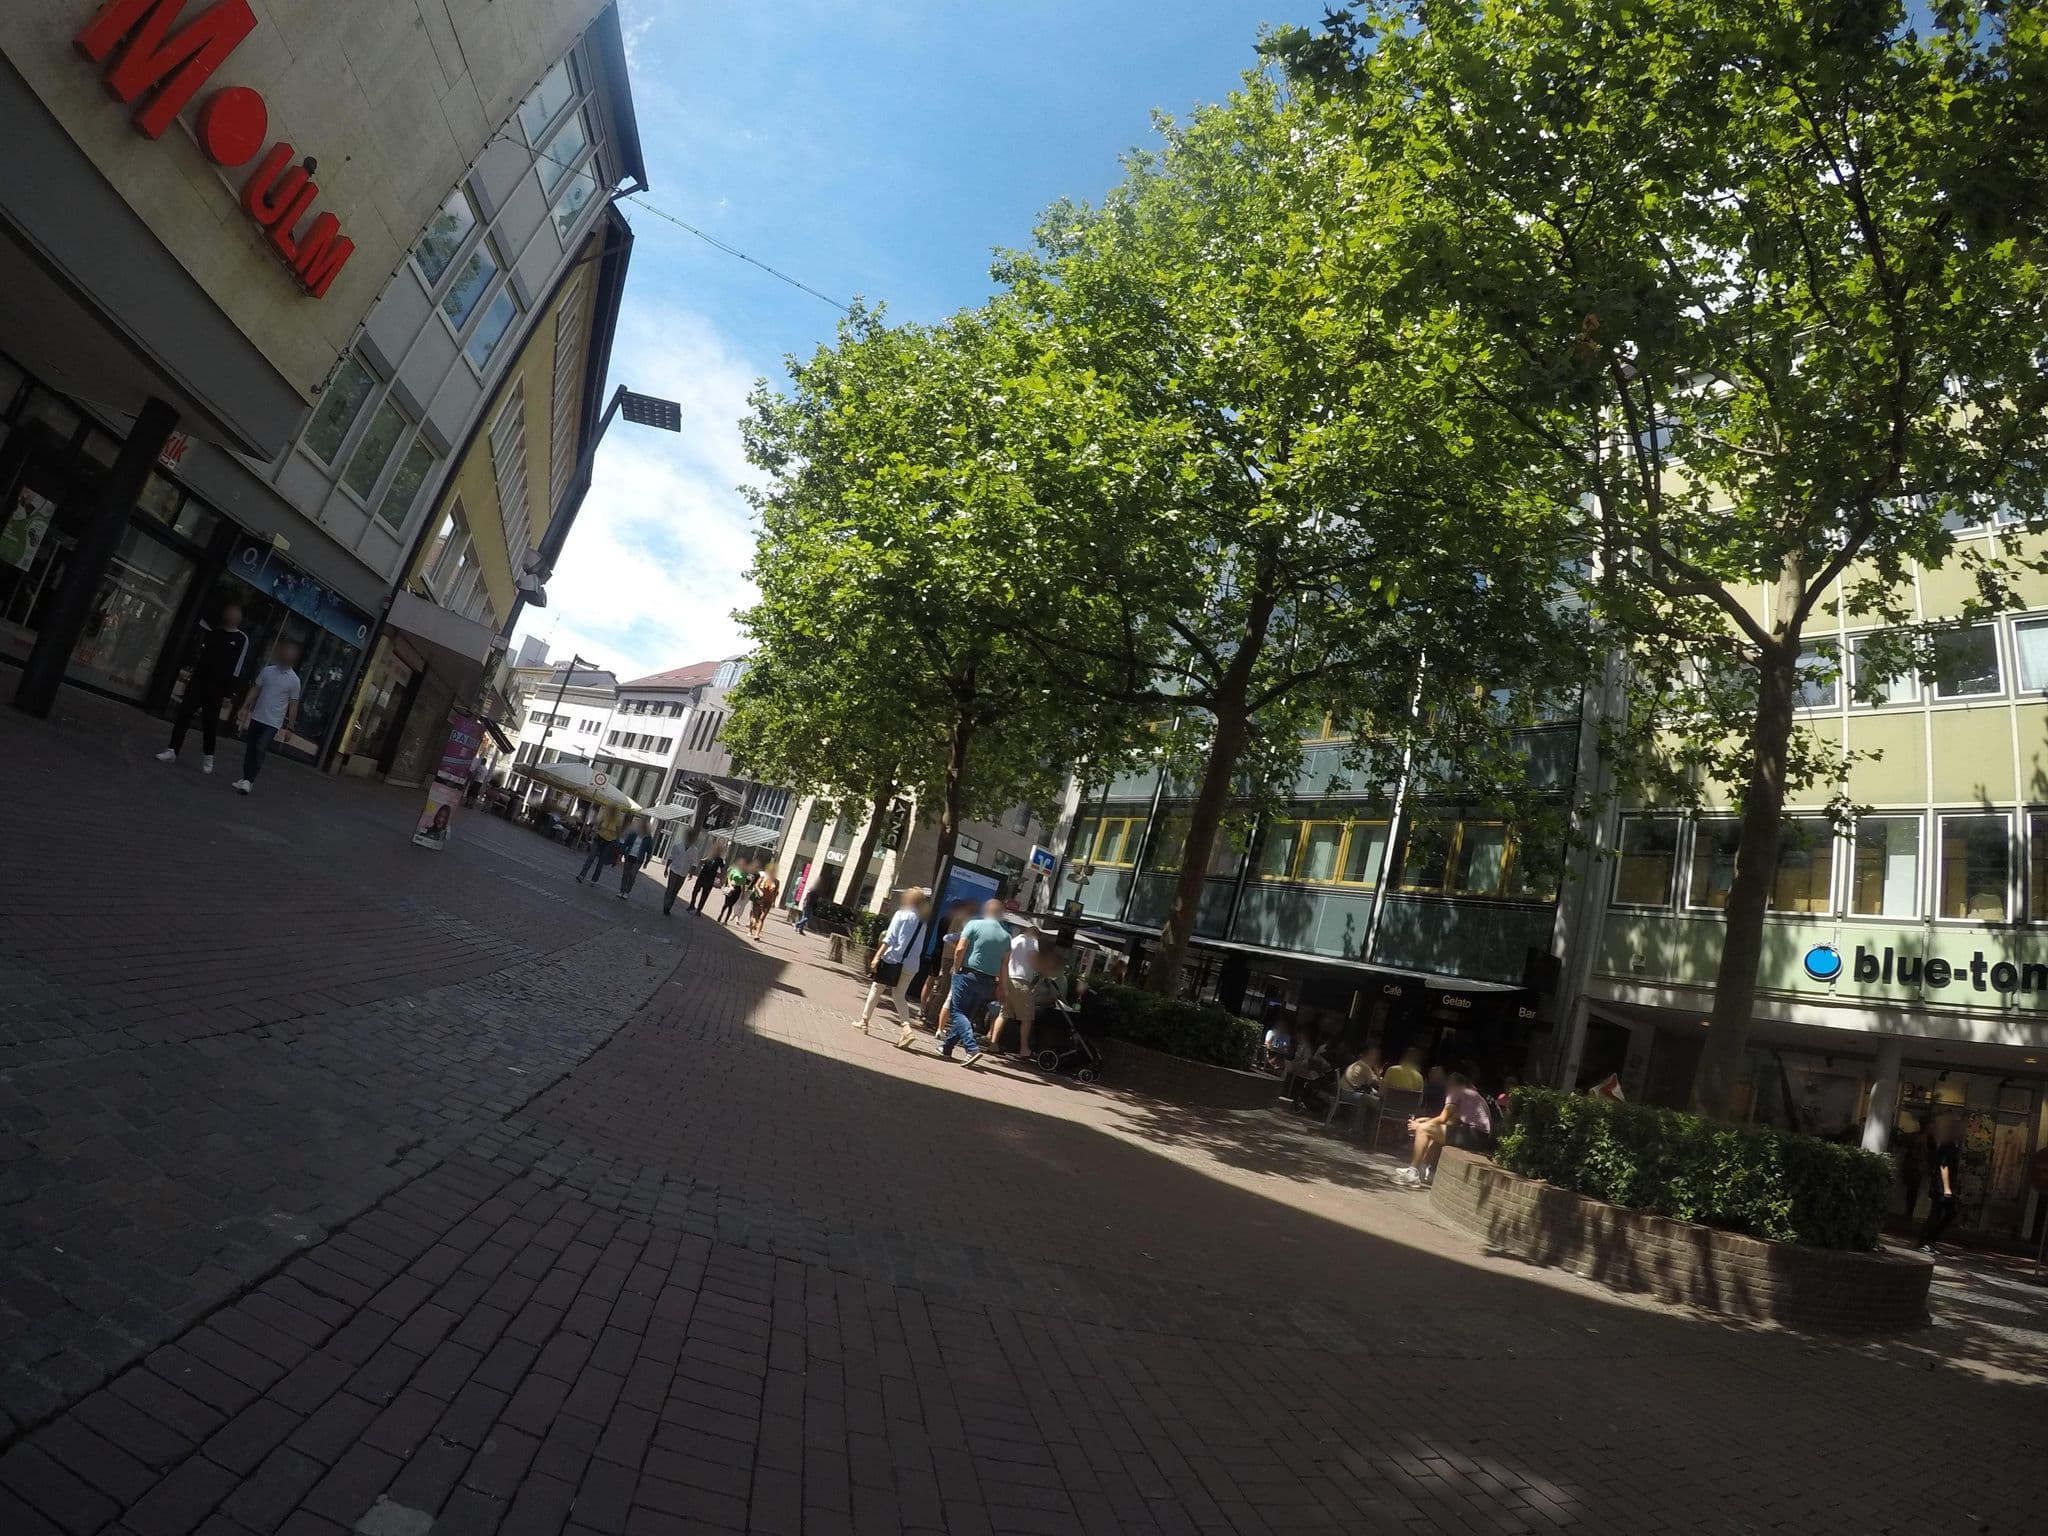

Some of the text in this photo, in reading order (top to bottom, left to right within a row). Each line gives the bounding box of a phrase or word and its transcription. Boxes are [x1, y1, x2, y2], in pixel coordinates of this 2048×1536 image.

[826, 851, 846, 862] ONLY
[1383, 984, 1402, 997] Café
[1442, 995, 1471, 1009] Gelato
[1518, 1006, 1537, 1019] Bar
